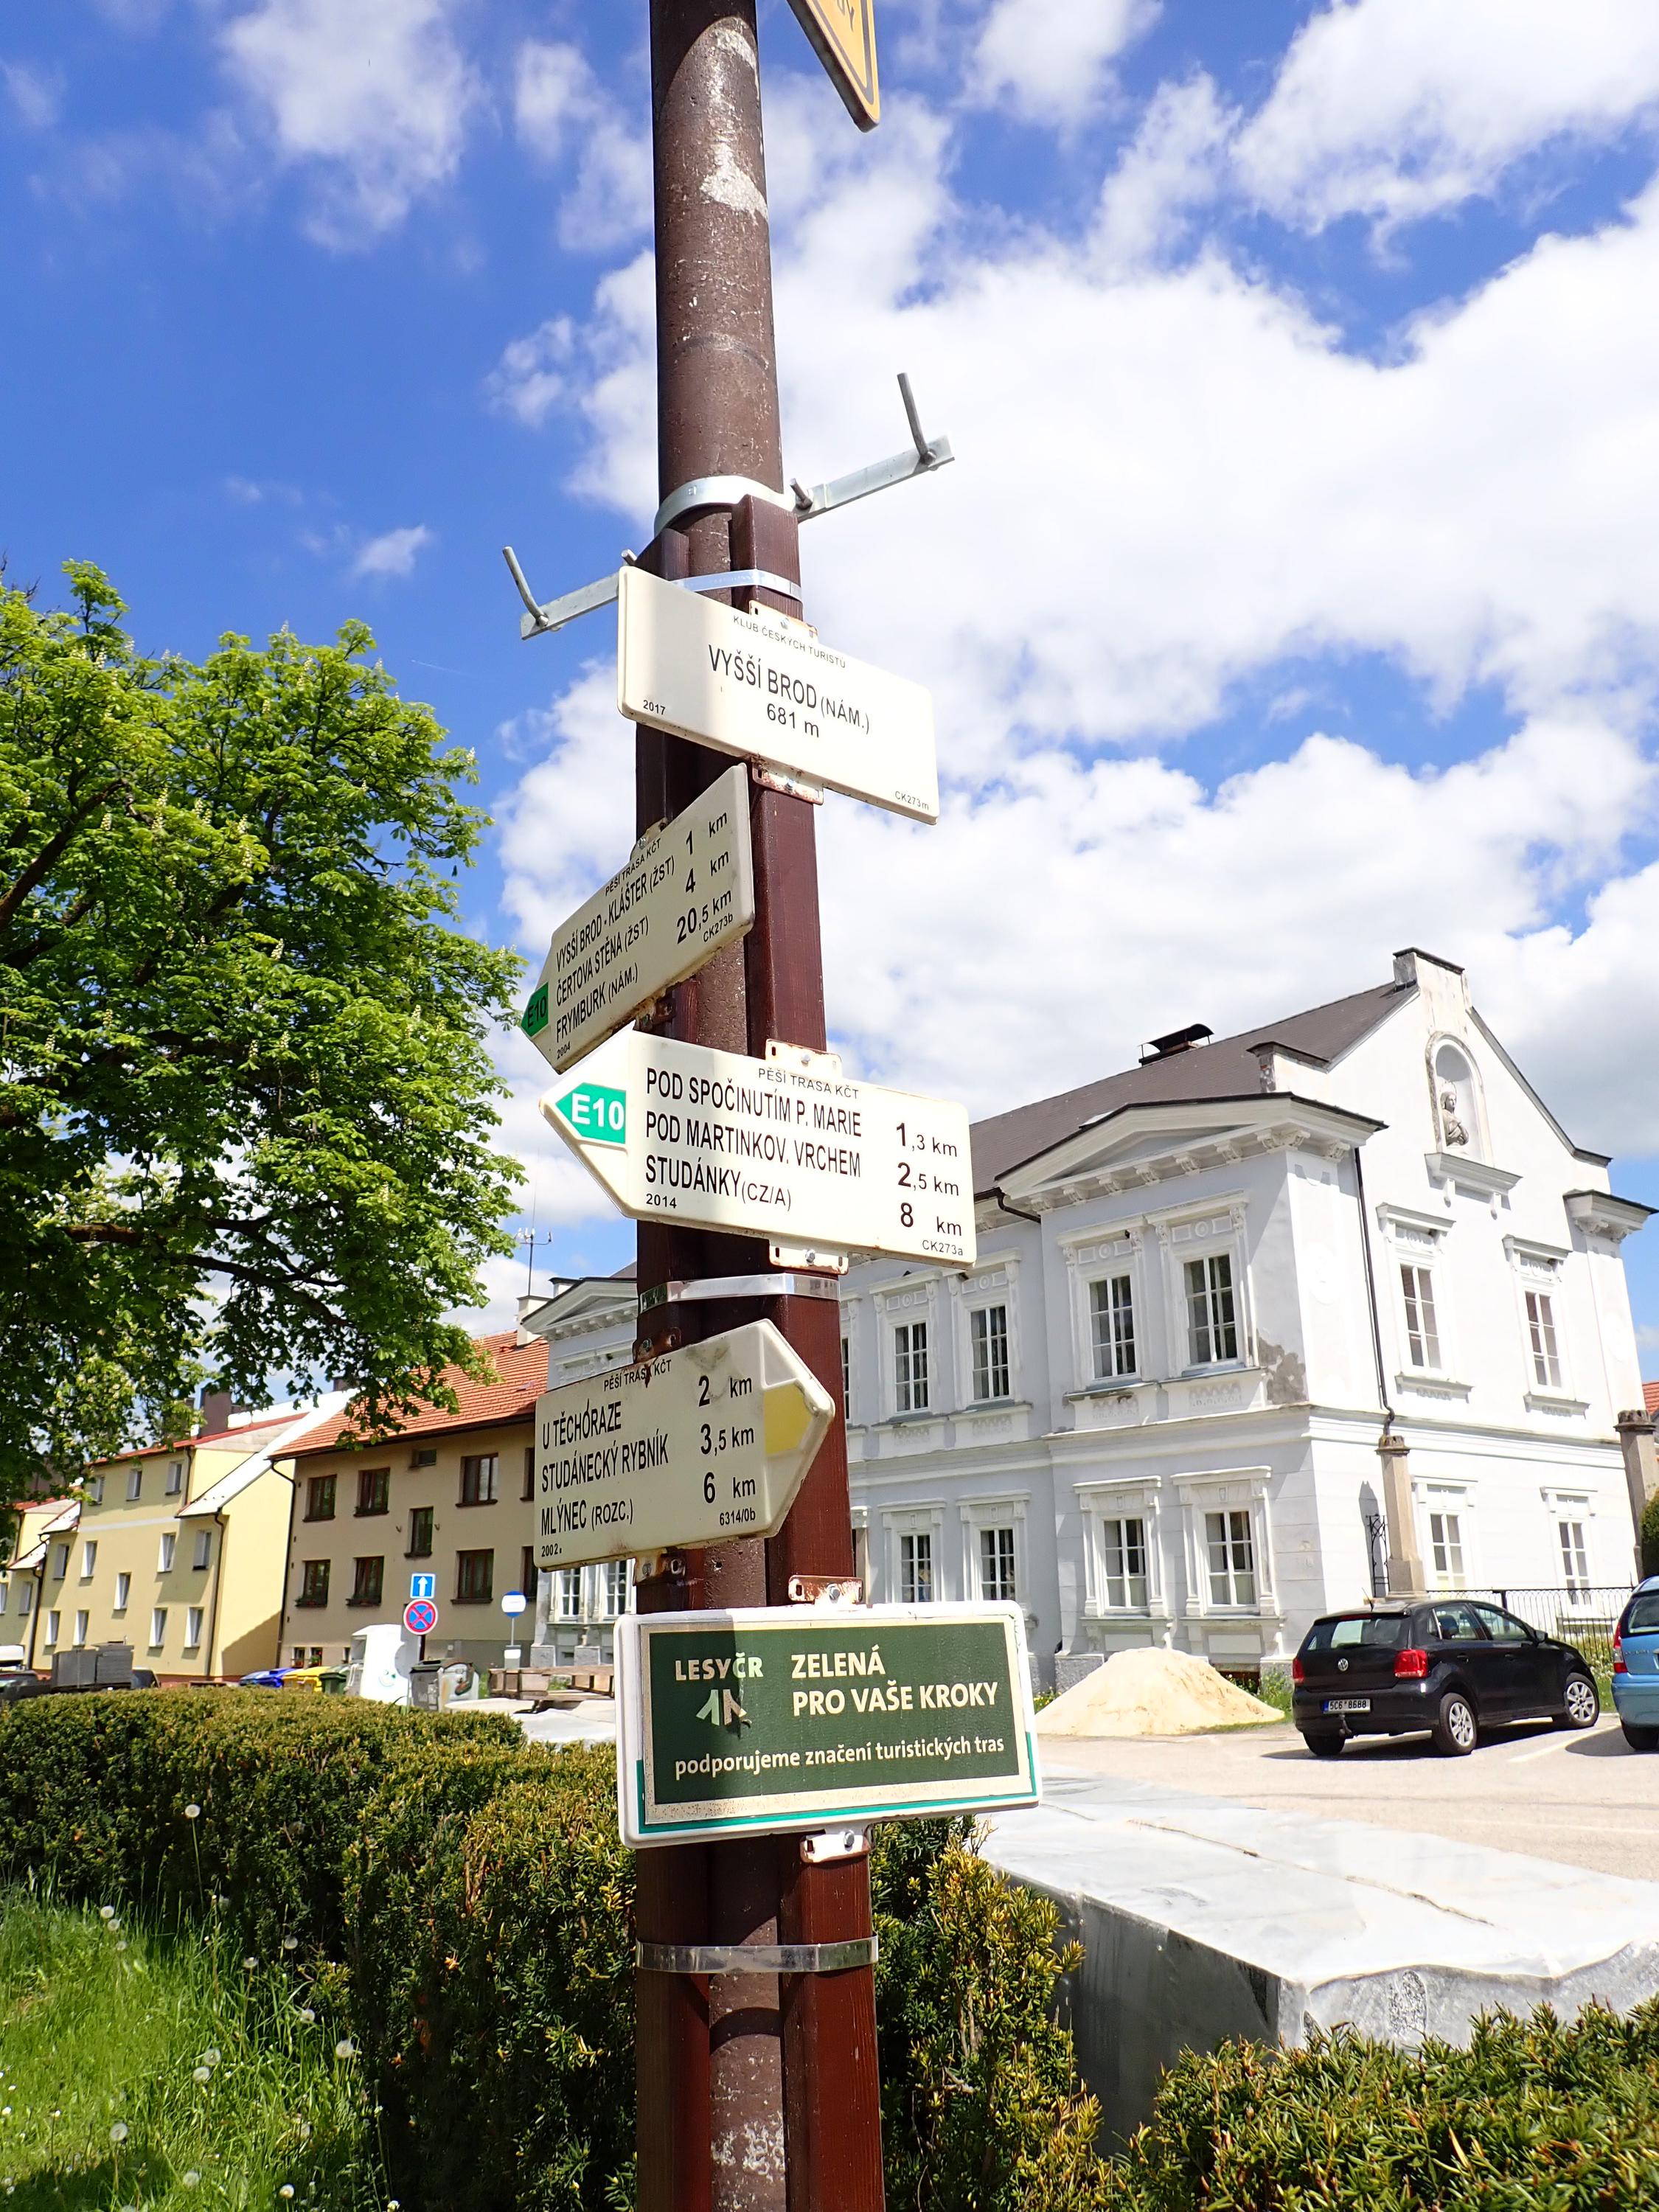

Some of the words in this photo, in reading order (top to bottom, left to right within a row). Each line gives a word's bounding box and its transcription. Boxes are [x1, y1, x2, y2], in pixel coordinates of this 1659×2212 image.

[733, 615, 759, 633] KLUB
[762, 625, 806, 652] ČESKÝCH
[643, 700, 666, 715] 2017
[709, 644, 761, 689] VYŠŠÍ
[768, 668, 816, 709] BROD
[821, 696, 869, 734] (NÁM.)
[767, 703, 796, 728] 681
[804, 720, 819, 737] m
[895, 790, 929, 811] CK273m
[622, 854, 645, 880] TRASA
[646, 838, 661, 858] KČT
[580, 914, 602, 953] BROD
[608, 872, 647, 926] KLÁŠTER
[650, 855, 675, 893] (ŽST)
[686, 830, 693, 855] 1
[709, 812, 727, 838] km
[556, 957, 594, 1007] ČERTOVA
[594, 931, 622, 974] STĚNA
[625, 915, 649, 953] (ŽST)
[685, 868, 696, 893] 4
[710, 851, 729, 877] km
[703, 912, 733, 942] CK273b
[556, 981, 606, 1043] FRYMBURK
[608, 962, 638, 1004] (NÁM.)
[677, 904, 709, 945] 20,5
[712, 890, 731, 915] km
[527, 995, 547, 1028] E10
[557, 1041, 571, 1060] 2004
[758, 1067, 787, 1084] PĚŠÍ
[790, 1074, 832, 1093] TRASA
[835, 1084, 859, 1099] KČT
[571, 1093, 625, 1130] E10
[647, 1067, 684, 1100] POD
[689, 1078, 790, 1123] SPOČINUTÍM
[796, 1099, 808, 1127] P.
[813, 1103, 861, 1137] MARIE
[896, 1122, 925, 1151] 1,3
[932, 1136, 958, 1157] km
[646, 1110, 681, 1143] POD
[686, 1118, 789, 1164] MARTINKOV.
[794, 1139, 860, 1178] VRCHEM
[897, 1162, 927, 1192] 2,5
[933, 1175, 959, 1196] km
[645, 1154, 741, 1197] STUDÁNKY
[742, 1180, 791, 1211] (CZ/A)
[900, 1202, 914, 1228] 8
[936, 1216, 961, 1237] km
[646, 1193, 677, 1209] 2014
[922, 1239, 963, 1256] CK273a
[604, 1372, 622, 1391] PĚŠÍ
[654, 1360, 672, 1376] KČT
[543, 1422, 550, 1450] U
[698, 1375, 711, 1407] 2
[730, 1377, 752, 1398] km
[542, 1440, 619, 1492] STUDÁNECKÝ
[622, 1428, 669, 1474] RYBNÍK
[700, 1423, 726, 1456] 3,5
[731, 1427, 754, 1448] km
[541, 1498, 586, 1536] MLÝNEC
[591, 1498, 633, 1531] (ROZC.)
[703, 1472, 716, 1503] 6
[733, 1477, 756, 1498] km
[720, 1507, 756, 1526] 6314/0b
[791, 1644, 886, 1679] ZELENÁ
[793, 1689, 846, 1717] PRO
[851, 1680, 914, 1713] VAŠE
[919, 1682, 998, 1709] KROKY
[675, 1750, 800, 1781] podporujeme
[805, 1742, 871, 1765] značení
[875, 1736, 971, 1761] turistických
[975, 1736, 1004, 1753] tras
